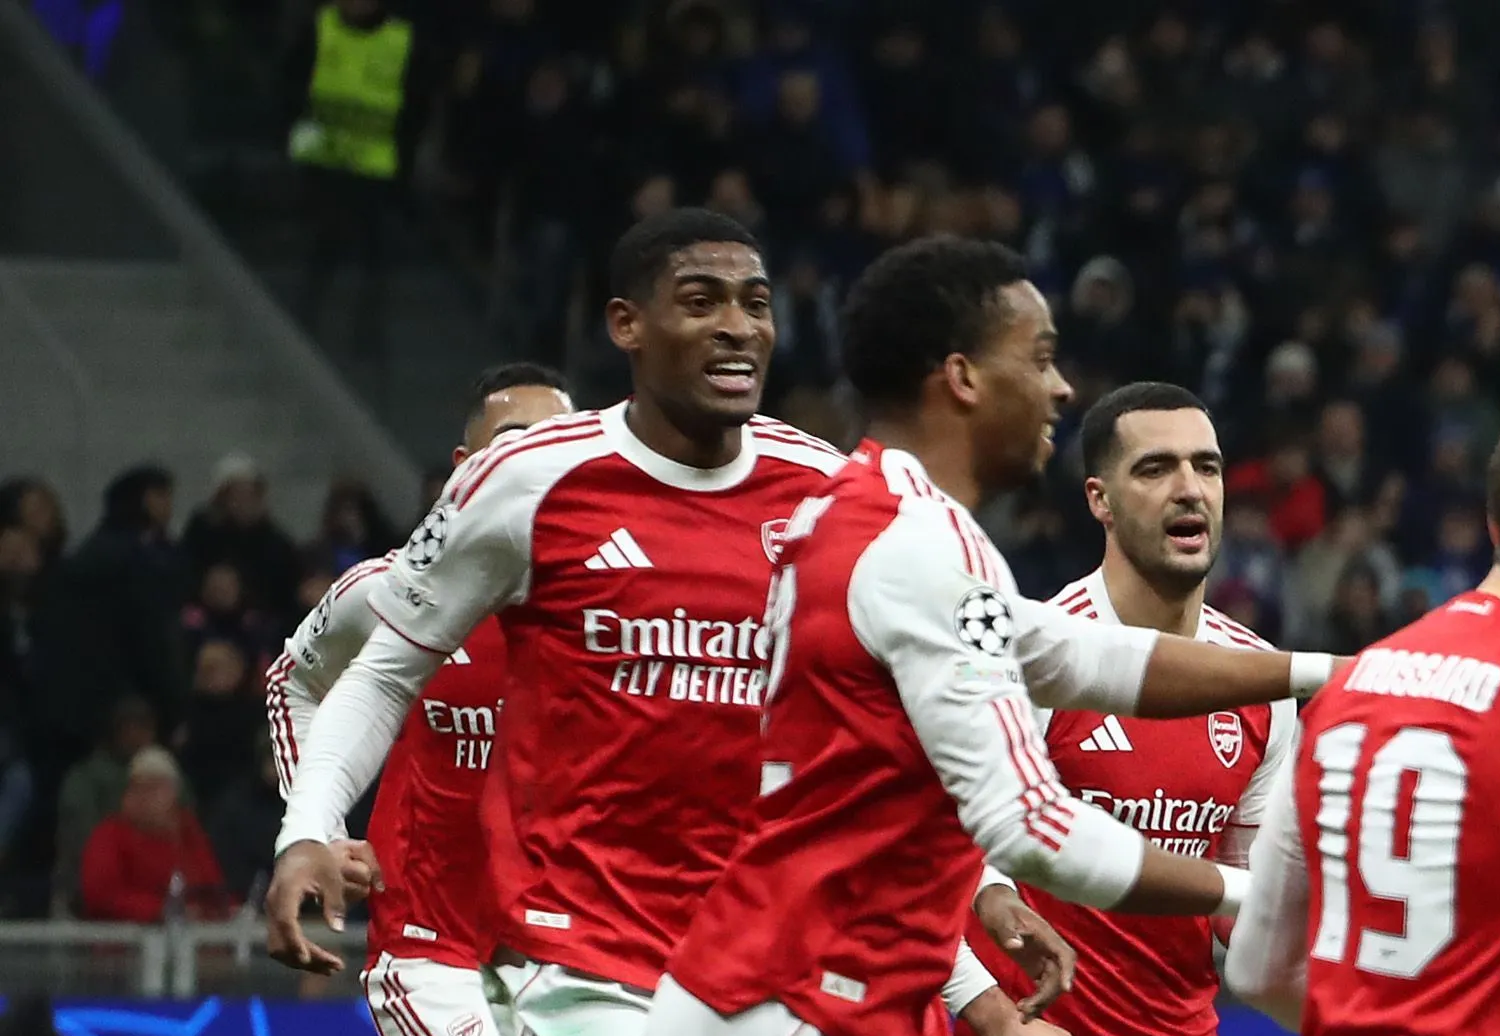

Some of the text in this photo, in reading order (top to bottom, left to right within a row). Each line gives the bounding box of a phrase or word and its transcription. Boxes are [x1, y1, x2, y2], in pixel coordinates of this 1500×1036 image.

[610, 660, 768, 706] FLY BETTER
[455, 739, 493, 770] FLY
[1311, 723, 1469, 980] 19
